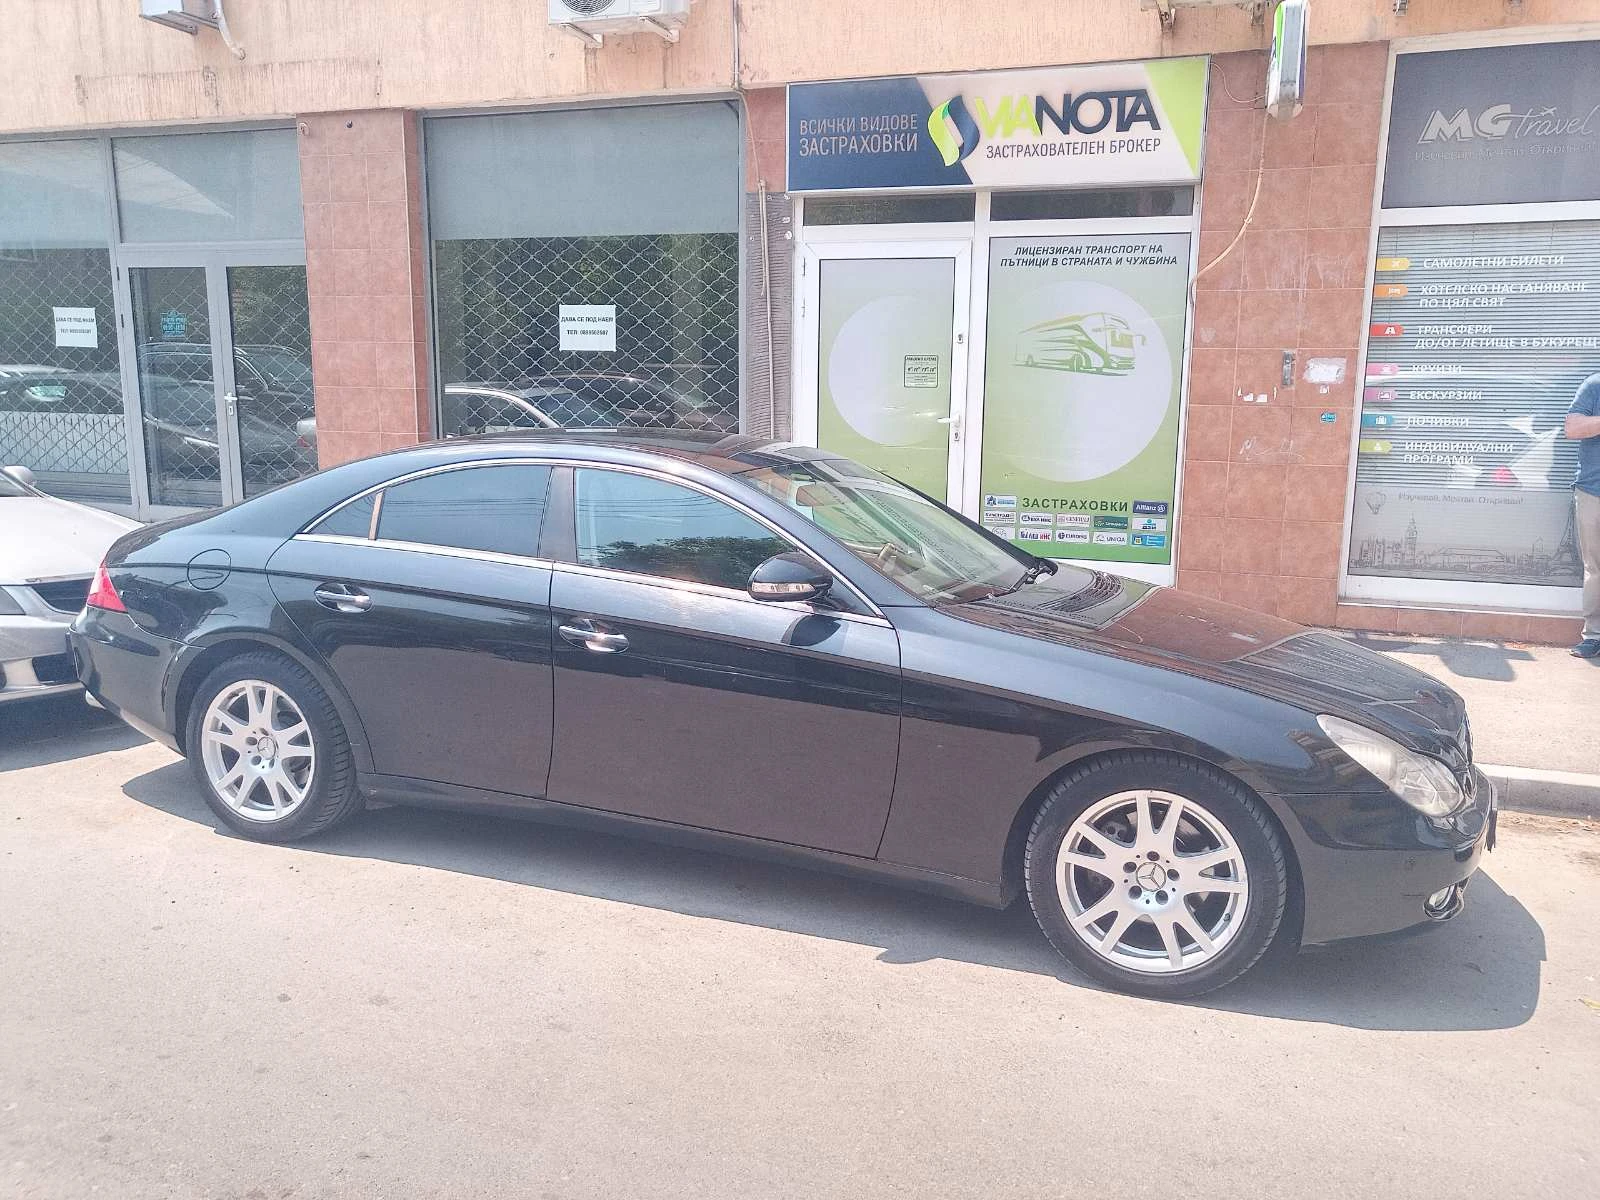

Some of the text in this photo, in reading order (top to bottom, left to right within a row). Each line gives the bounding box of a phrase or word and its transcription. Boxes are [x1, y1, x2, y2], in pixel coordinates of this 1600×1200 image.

[975, 88, 1162, 138] VIANOTA
[799, 113, 918, 135] ВСИЧКИ ВИДОВЕ
[1417, 103, 1512, 144] MG
[799, 132, 918, 157] ЗАСТРАХОВКИ
[986, 137, 1161, 159] ЗАСТРАХОВАТЕЛЕН БРОКЕР
[1014, 244, 1163, 257] ЛИЦЕНЗИРАН ТРАНСПОРТ НА
[1000, 256, 1177, 268] ПЪТНИЦИ В СТРАНАТА И ЧУЖБИНА
[1423, 255, 1565, 268] САМОЛЕТНИ БИЛЕТИ
[1420, 284, 1490, 295] ХОТЕЛСКО
[1419, 297, 1506, 309] ПО ЦЯЛ СВЯТ
[1417, 325, 1493, 335] ТРАНСФЕРИ
[1462, 338, 1516, 349] ЛЕТИЩЕ
[1409, 390, 1483, 400] ЕКСКУРЗИИ
[1405, 441, 1513, 454] ИНДИВИДУАЛНИ
[1403, 454, 1474, 464] ПРОГРАМИ
[1022, 497, 1128, 512] ЗАСТРАХОВКИ
[1135, 503, 1157, 512] Allianz
